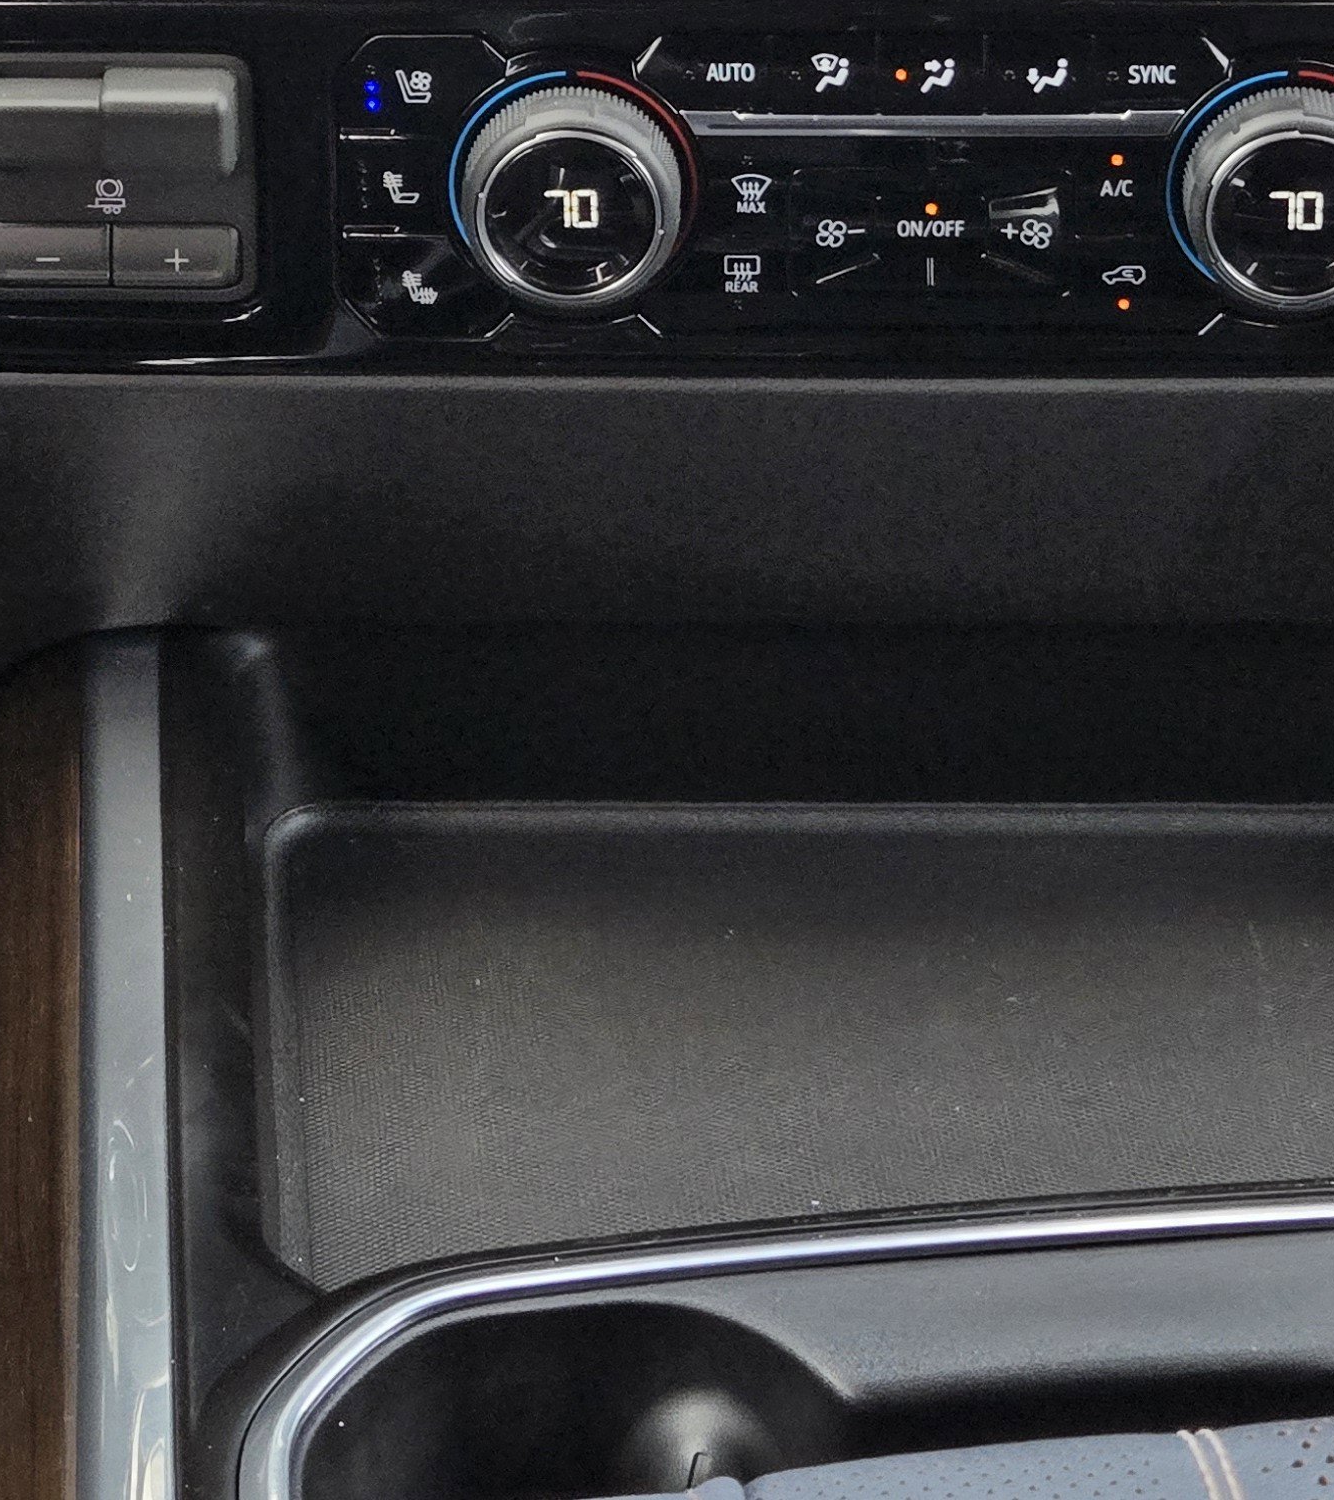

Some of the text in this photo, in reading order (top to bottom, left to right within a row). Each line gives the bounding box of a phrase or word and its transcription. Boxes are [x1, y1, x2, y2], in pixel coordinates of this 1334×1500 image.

[705, 62, 756, 84] AUTO
[1127, 63, 1177, 86] SYNC
[1099, 178, 1134, 199] A/C
[544, 188, 599, 230] 70
[736, 200, 767, 215] MAX
[1268, 190, 1325, 232] 70
[895, 218, 966, 240] ON/OFF
[724, 279, 759, 294] REAR
